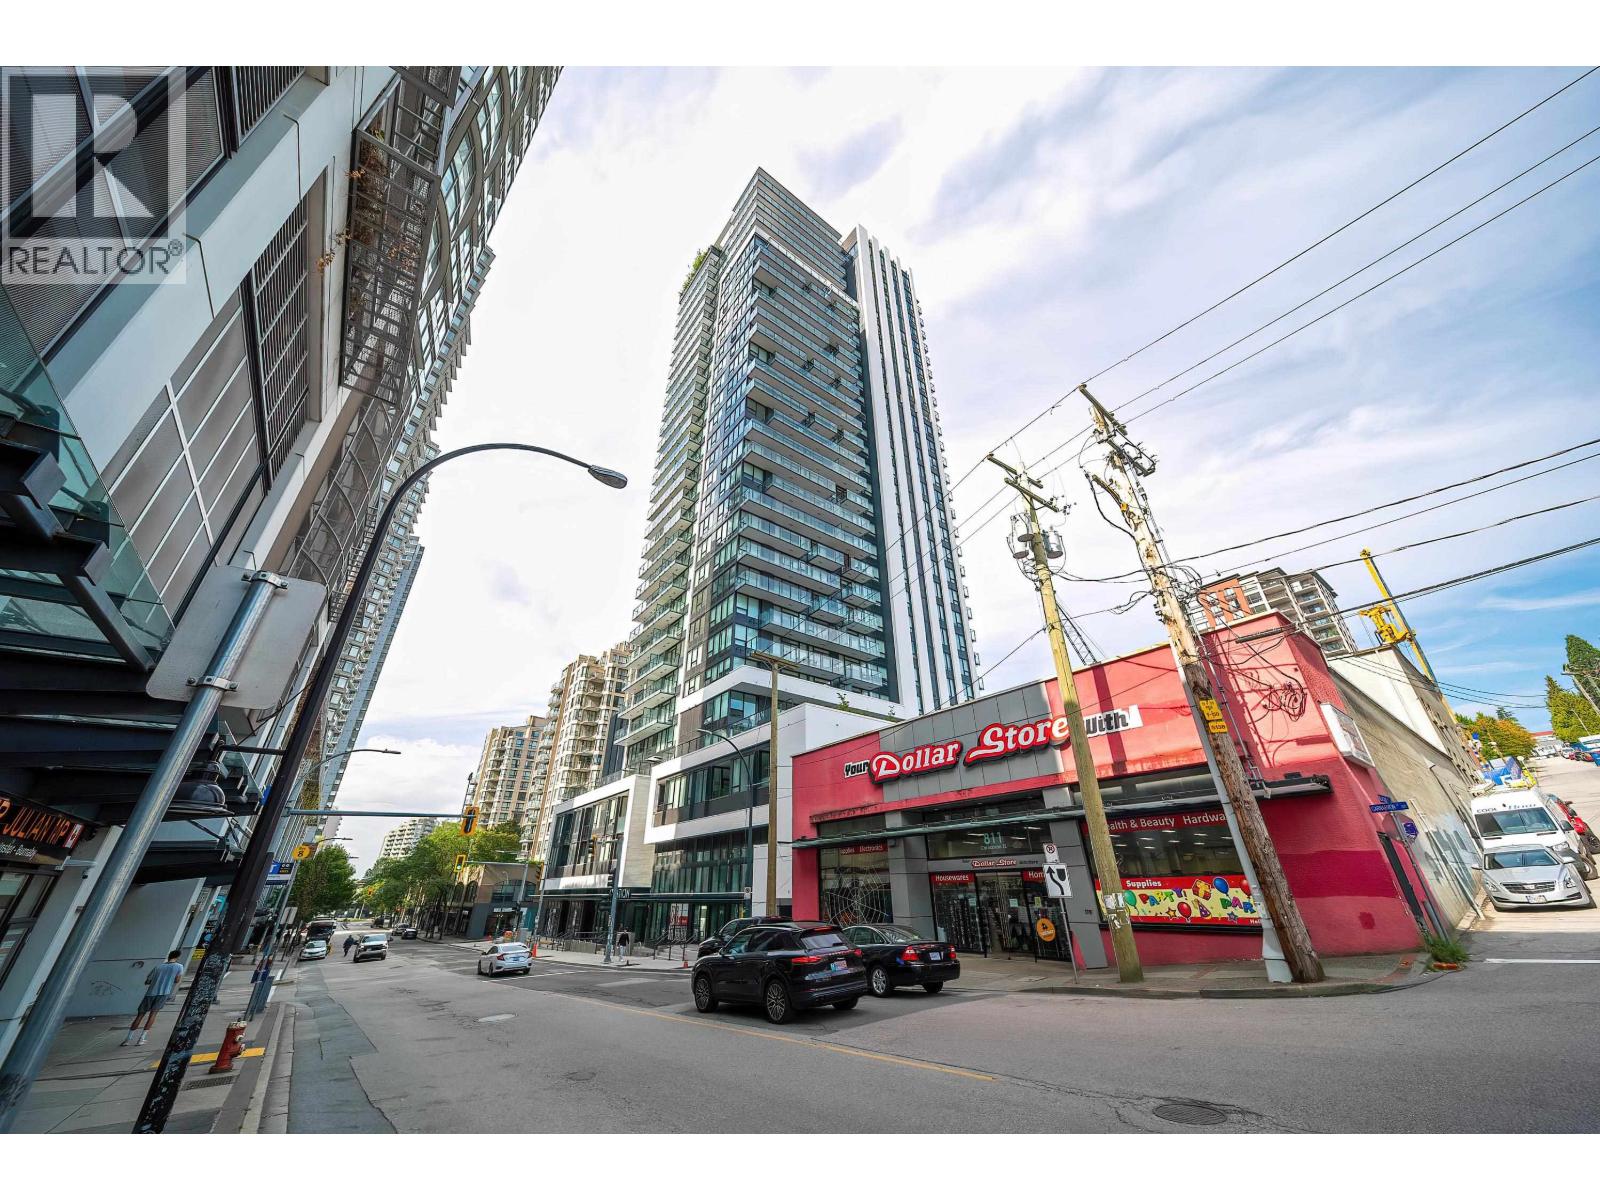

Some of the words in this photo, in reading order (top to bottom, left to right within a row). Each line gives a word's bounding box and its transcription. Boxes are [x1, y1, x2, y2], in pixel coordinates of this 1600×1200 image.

[845, 762, 868, 776] Your
[872, 743, 960, 778] Dollar
[969, 716, 1070, 758] Store
[1130, 820, 1138, 828] &
[1140, 817, 1175, 827] Beauty
[984, 832, 1002, 845] 811
[996, 858, 1017, 866] Store
[1126, 879, 1162, 888] Supplies
